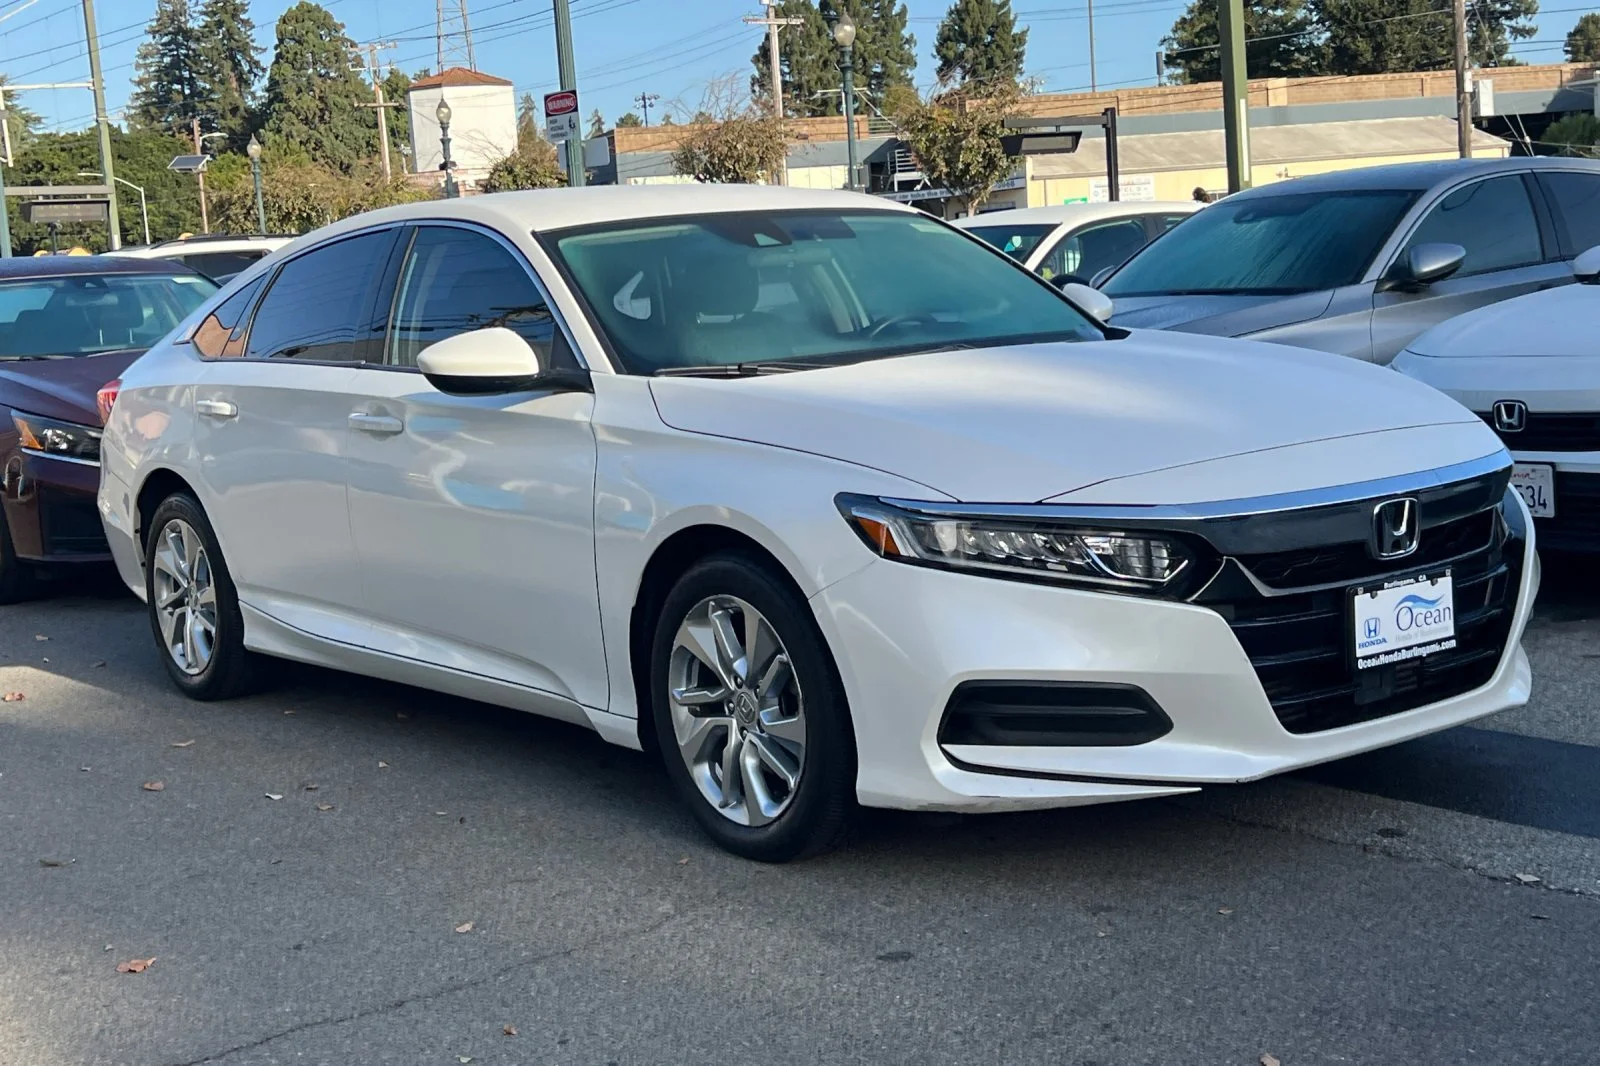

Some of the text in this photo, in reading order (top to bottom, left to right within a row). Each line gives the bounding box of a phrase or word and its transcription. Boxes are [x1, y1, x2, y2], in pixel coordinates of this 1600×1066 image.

[547, 97, 575, 110] WARNING
[1396, 606, 1452, 631] Ocean
[1358, 637, 1388, 649] HONDA
